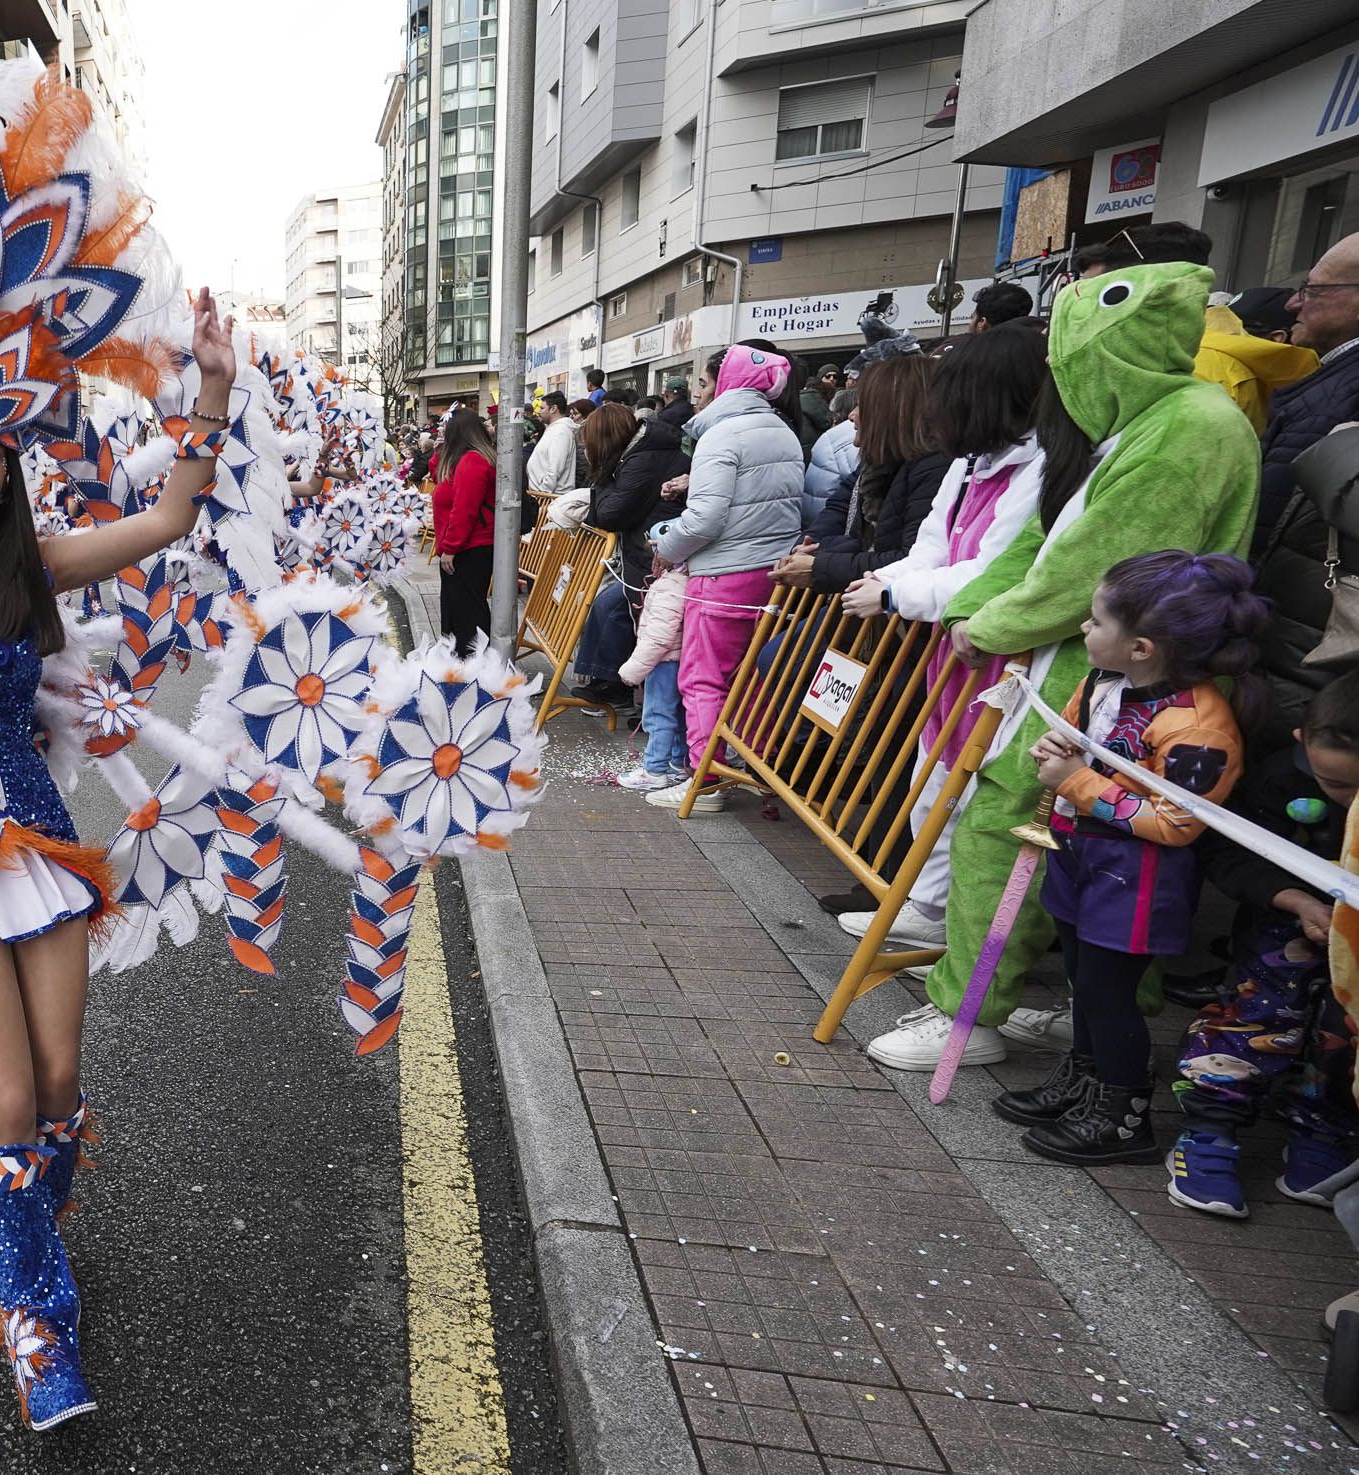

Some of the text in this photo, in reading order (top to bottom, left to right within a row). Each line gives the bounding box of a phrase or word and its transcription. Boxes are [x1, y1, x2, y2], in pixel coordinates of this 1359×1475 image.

[752, 301, 840, 319] Empleadas
[759, 318, 834, 333] de Hogar
